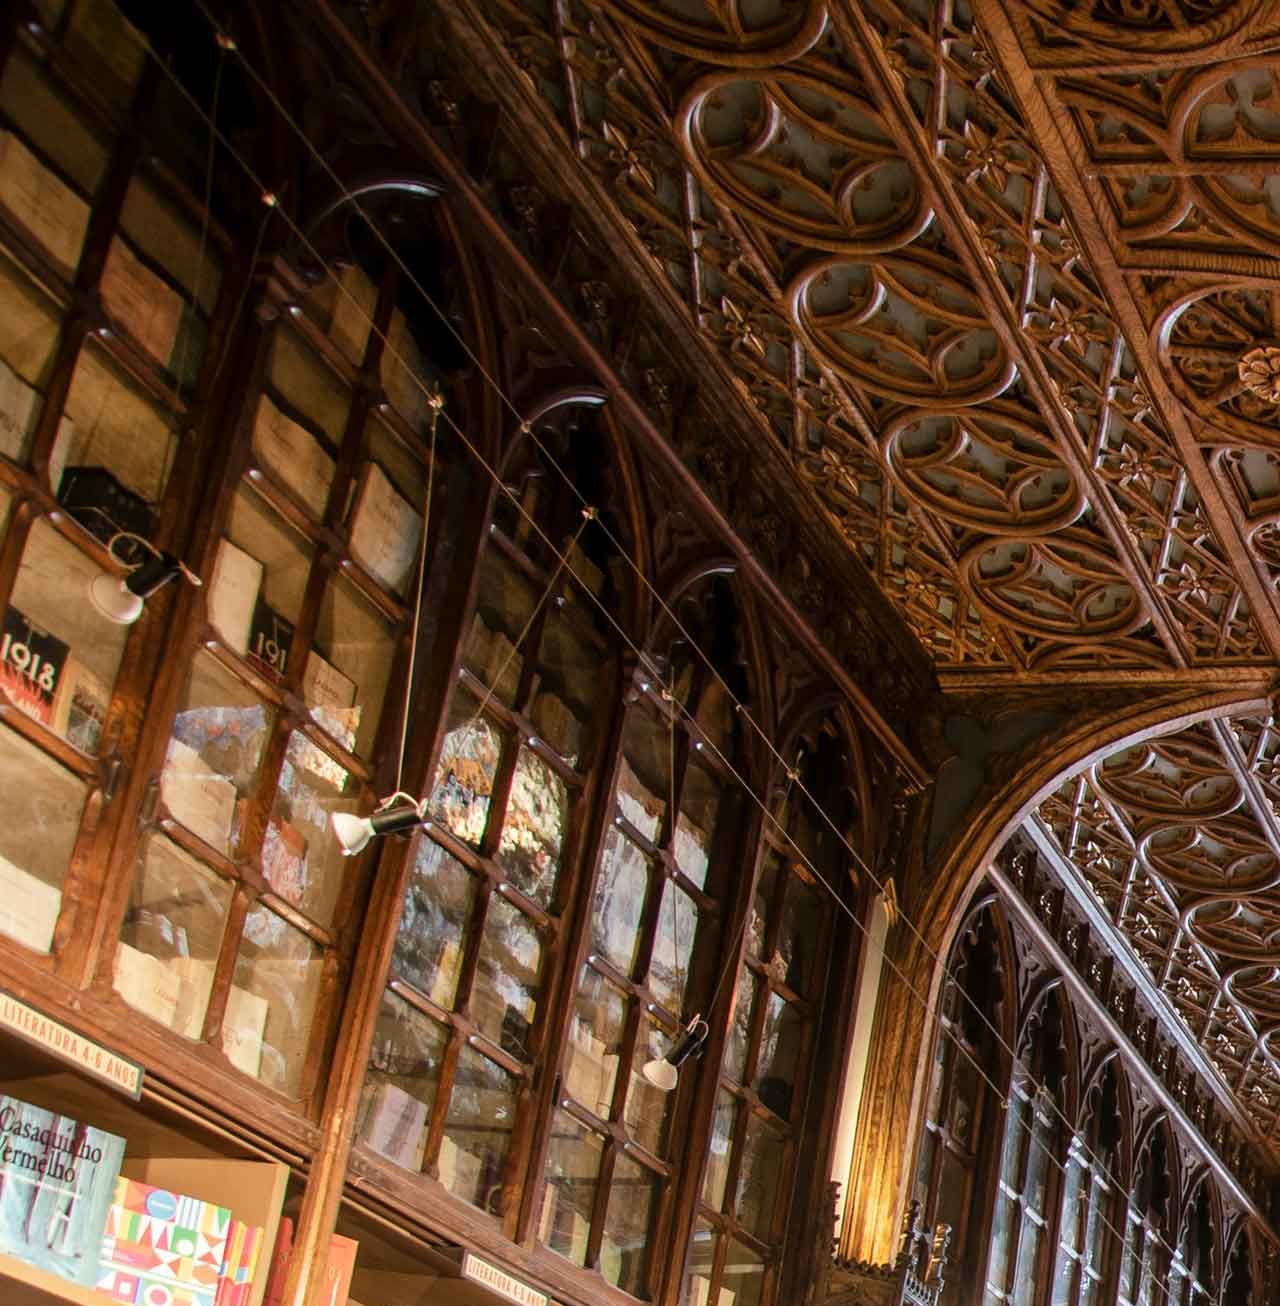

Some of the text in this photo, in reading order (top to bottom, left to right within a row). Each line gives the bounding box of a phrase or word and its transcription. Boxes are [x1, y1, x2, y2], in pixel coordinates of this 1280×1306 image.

[1, 633, 55, 693] 1918
[4, 1003, 78, 1060] LITERATURA
[106, 1056, 137, 1088] ANOS
